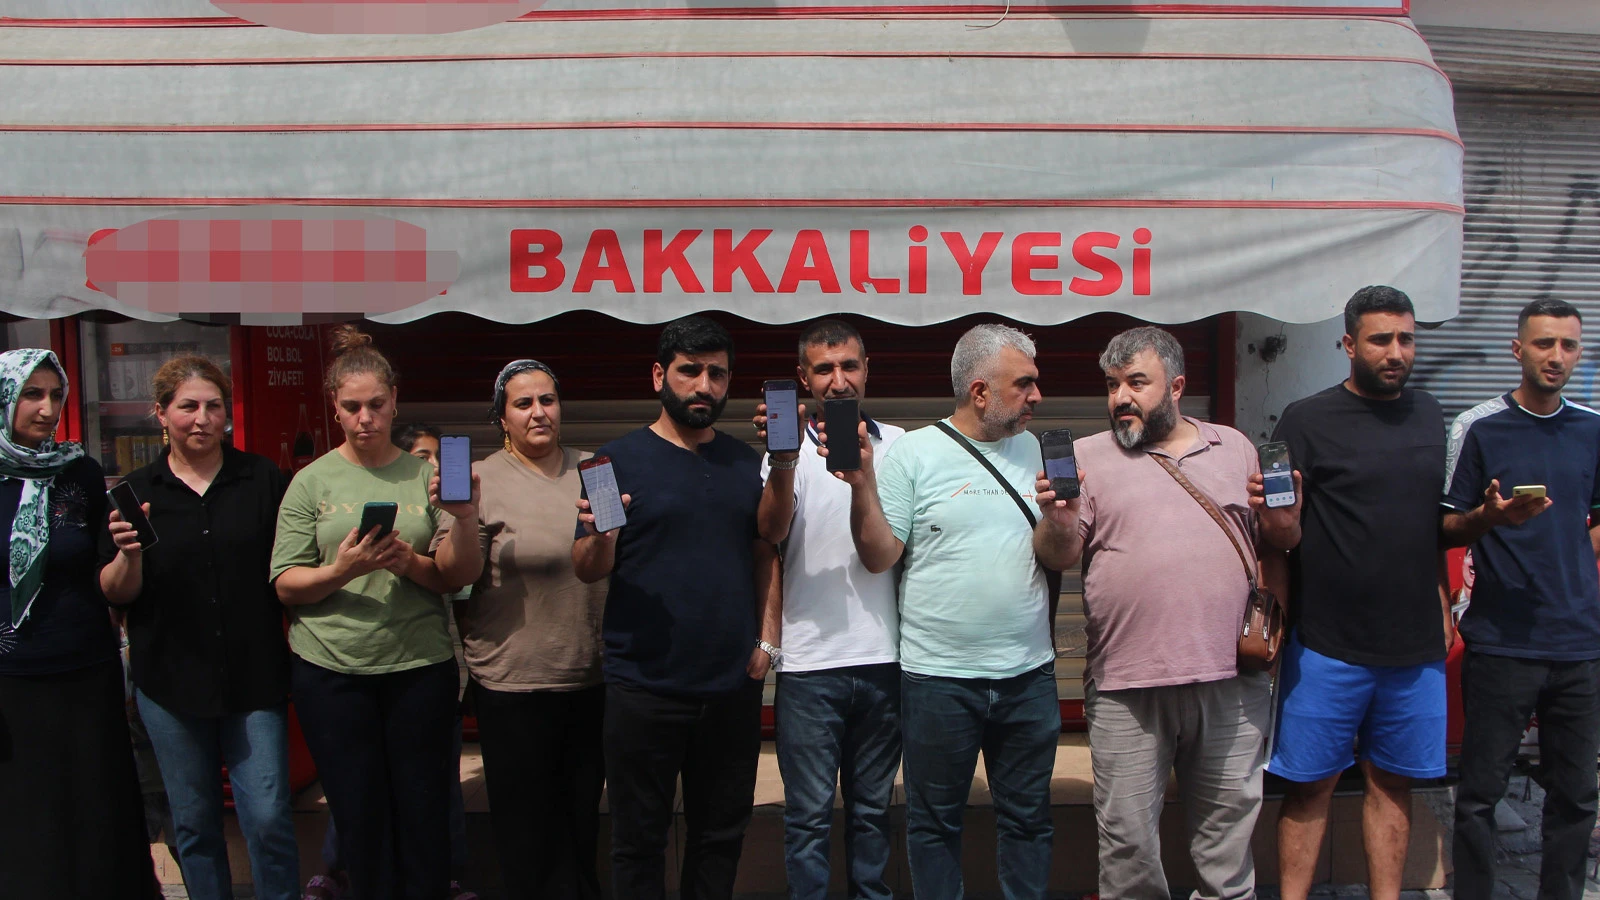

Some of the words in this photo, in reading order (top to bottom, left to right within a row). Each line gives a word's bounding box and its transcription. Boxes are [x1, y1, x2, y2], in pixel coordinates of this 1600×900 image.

[509, 225, 1152, 296] BAKKALİYESİ
[267, 346, 284, 362] BOL
[286, 347, 303, 363] BOL
[983, 488, 999, 496] THAN
